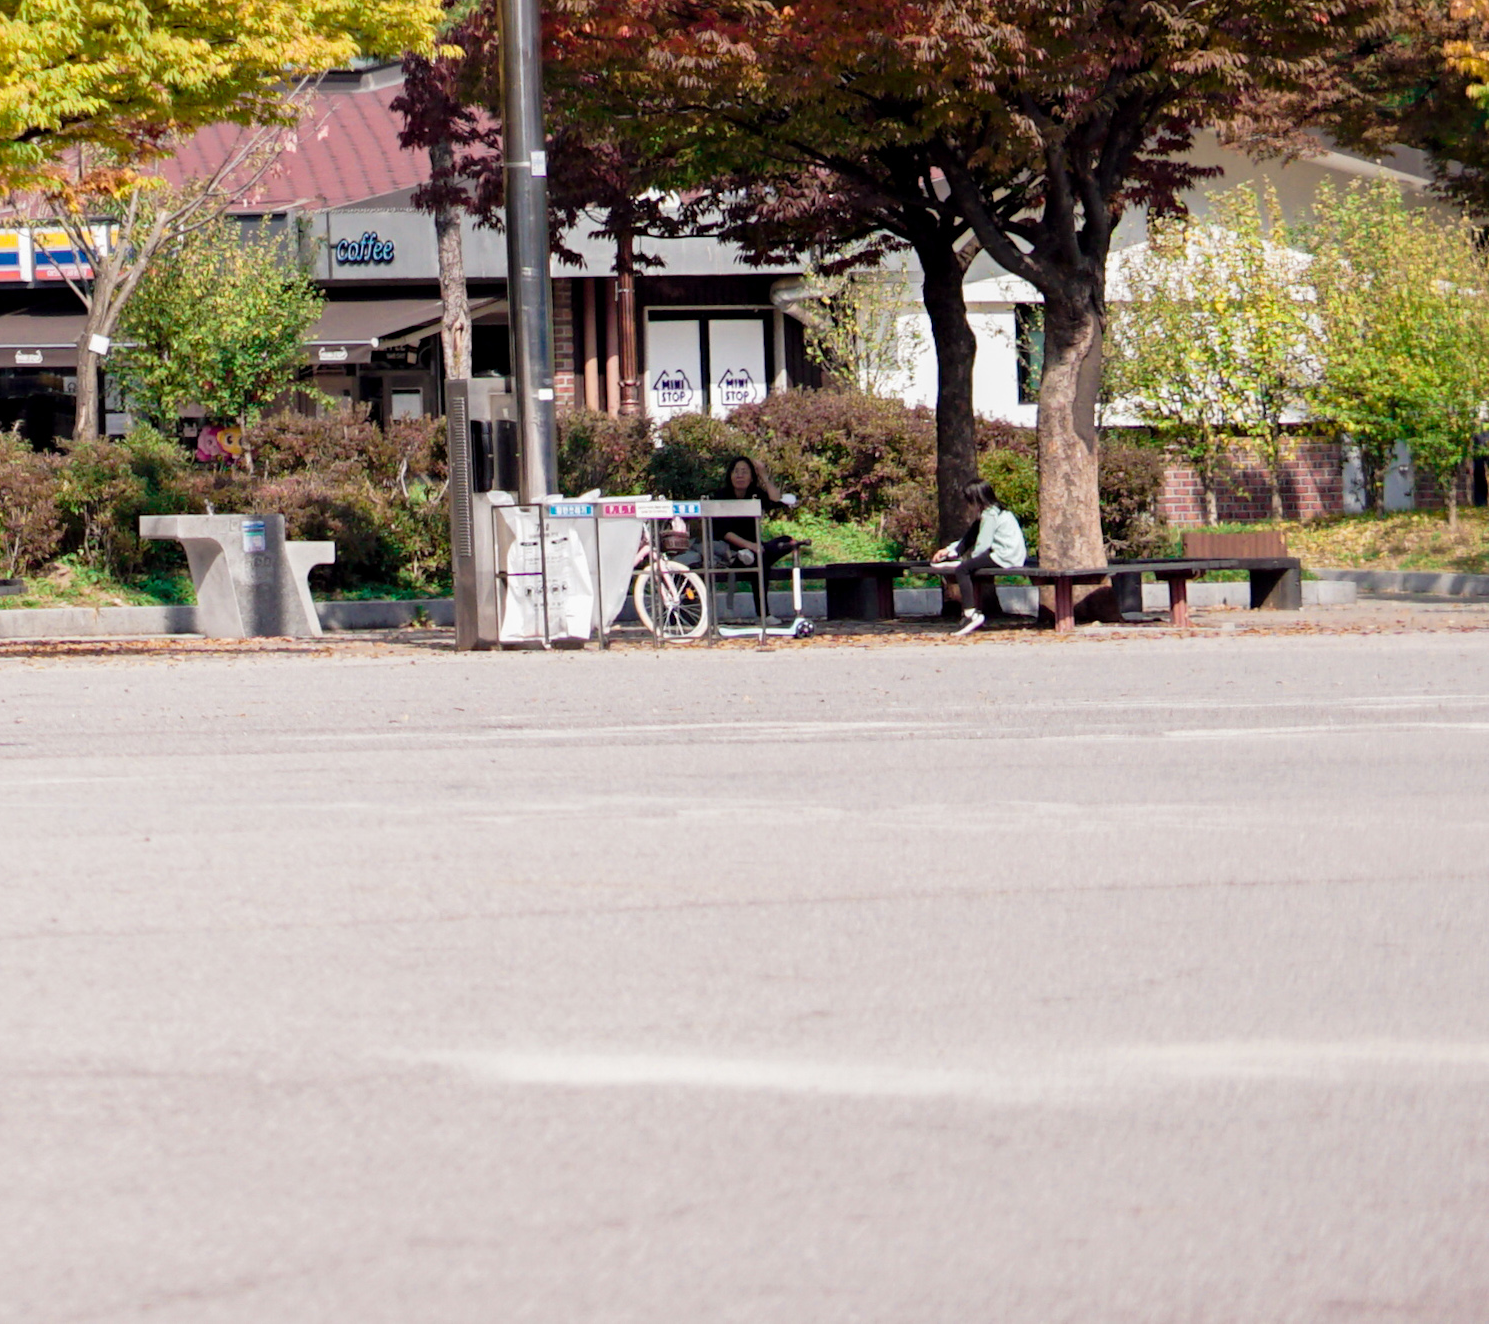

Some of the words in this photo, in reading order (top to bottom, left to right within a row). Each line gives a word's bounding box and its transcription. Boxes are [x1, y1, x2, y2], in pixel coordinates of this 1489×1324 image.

[336, 231, 395, 263] coffee
[662, 379, 684, 390] MINI
[725, 378, 749, 389] MINI
[661, 391, 686, 402] STOP
[725, 391, 750, 401] STOP
